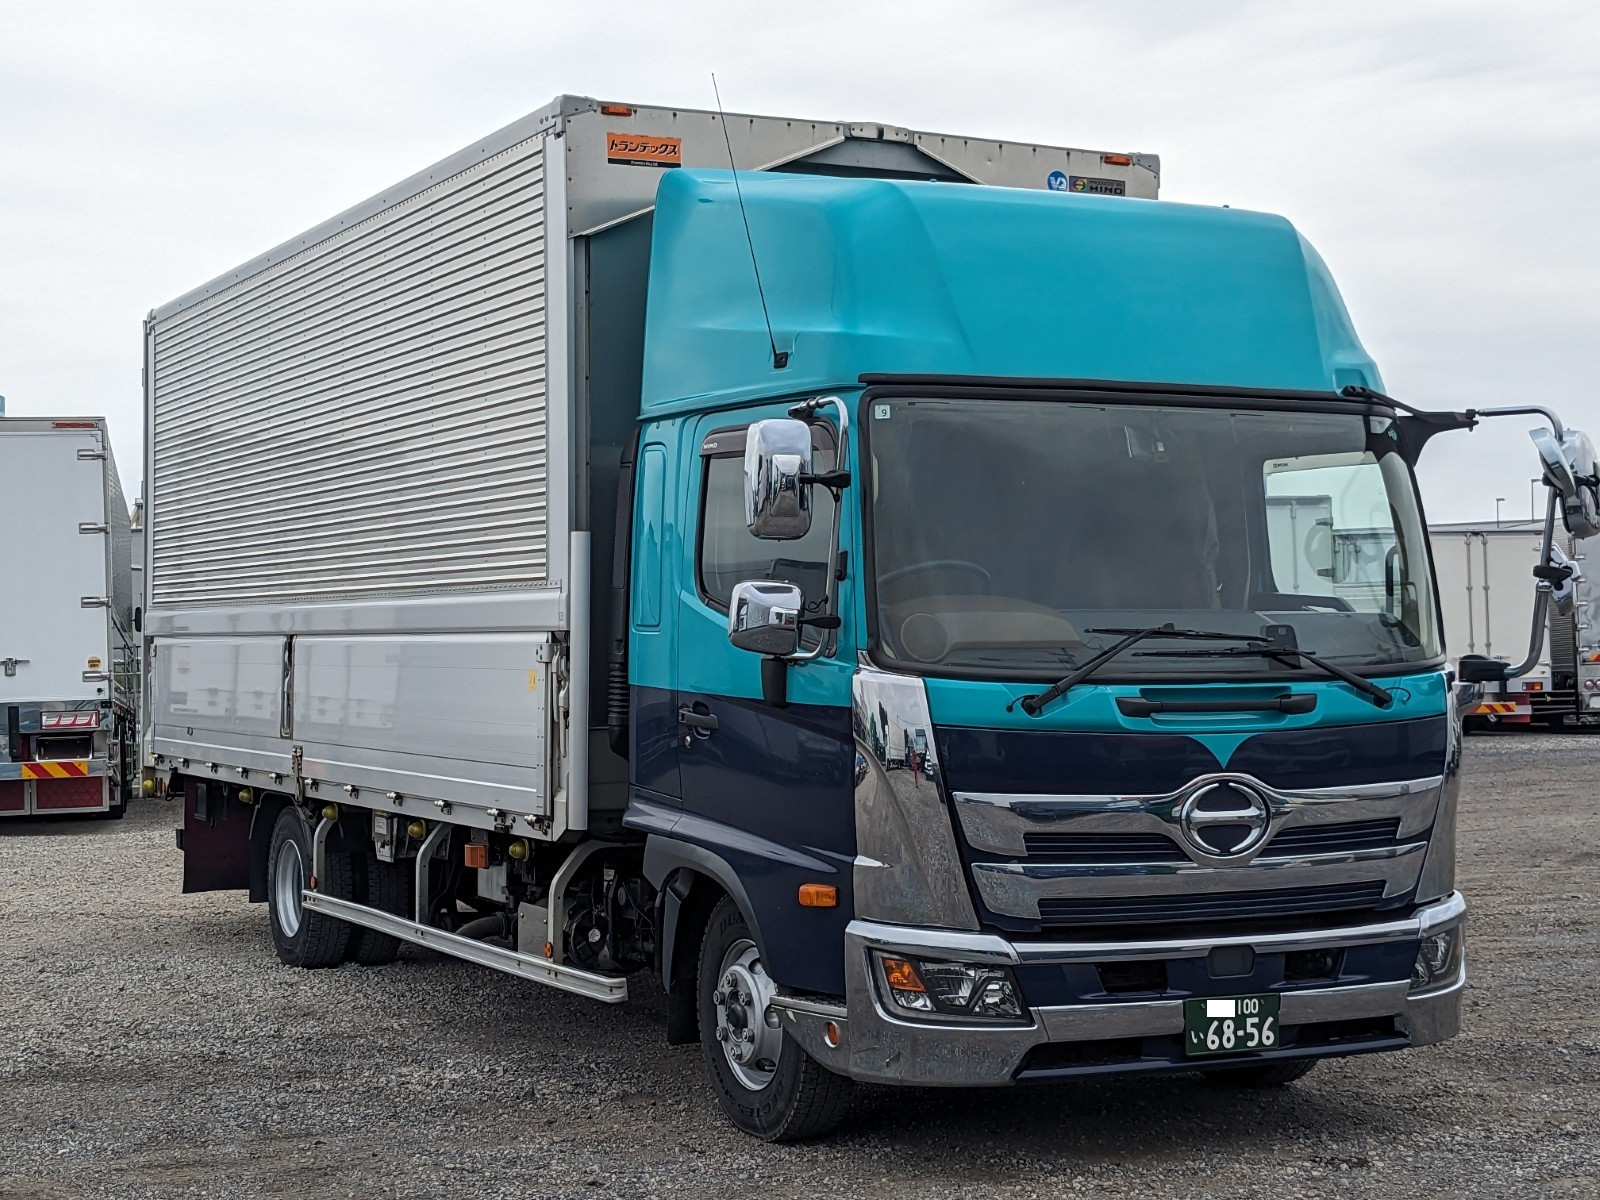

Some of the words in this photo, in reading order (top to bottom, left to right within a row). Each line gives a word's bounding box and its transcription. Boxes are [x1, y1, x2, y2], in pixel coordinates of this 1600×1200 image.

[609, 139, 679, 156] トランテックス
[1089, 185, 1123, 195] HINO
[1237, 998, 1259, 1015] 100
[1190, 1030, 1205, 1044] い
[1206, 1016, 1275, 1050] 68-56
